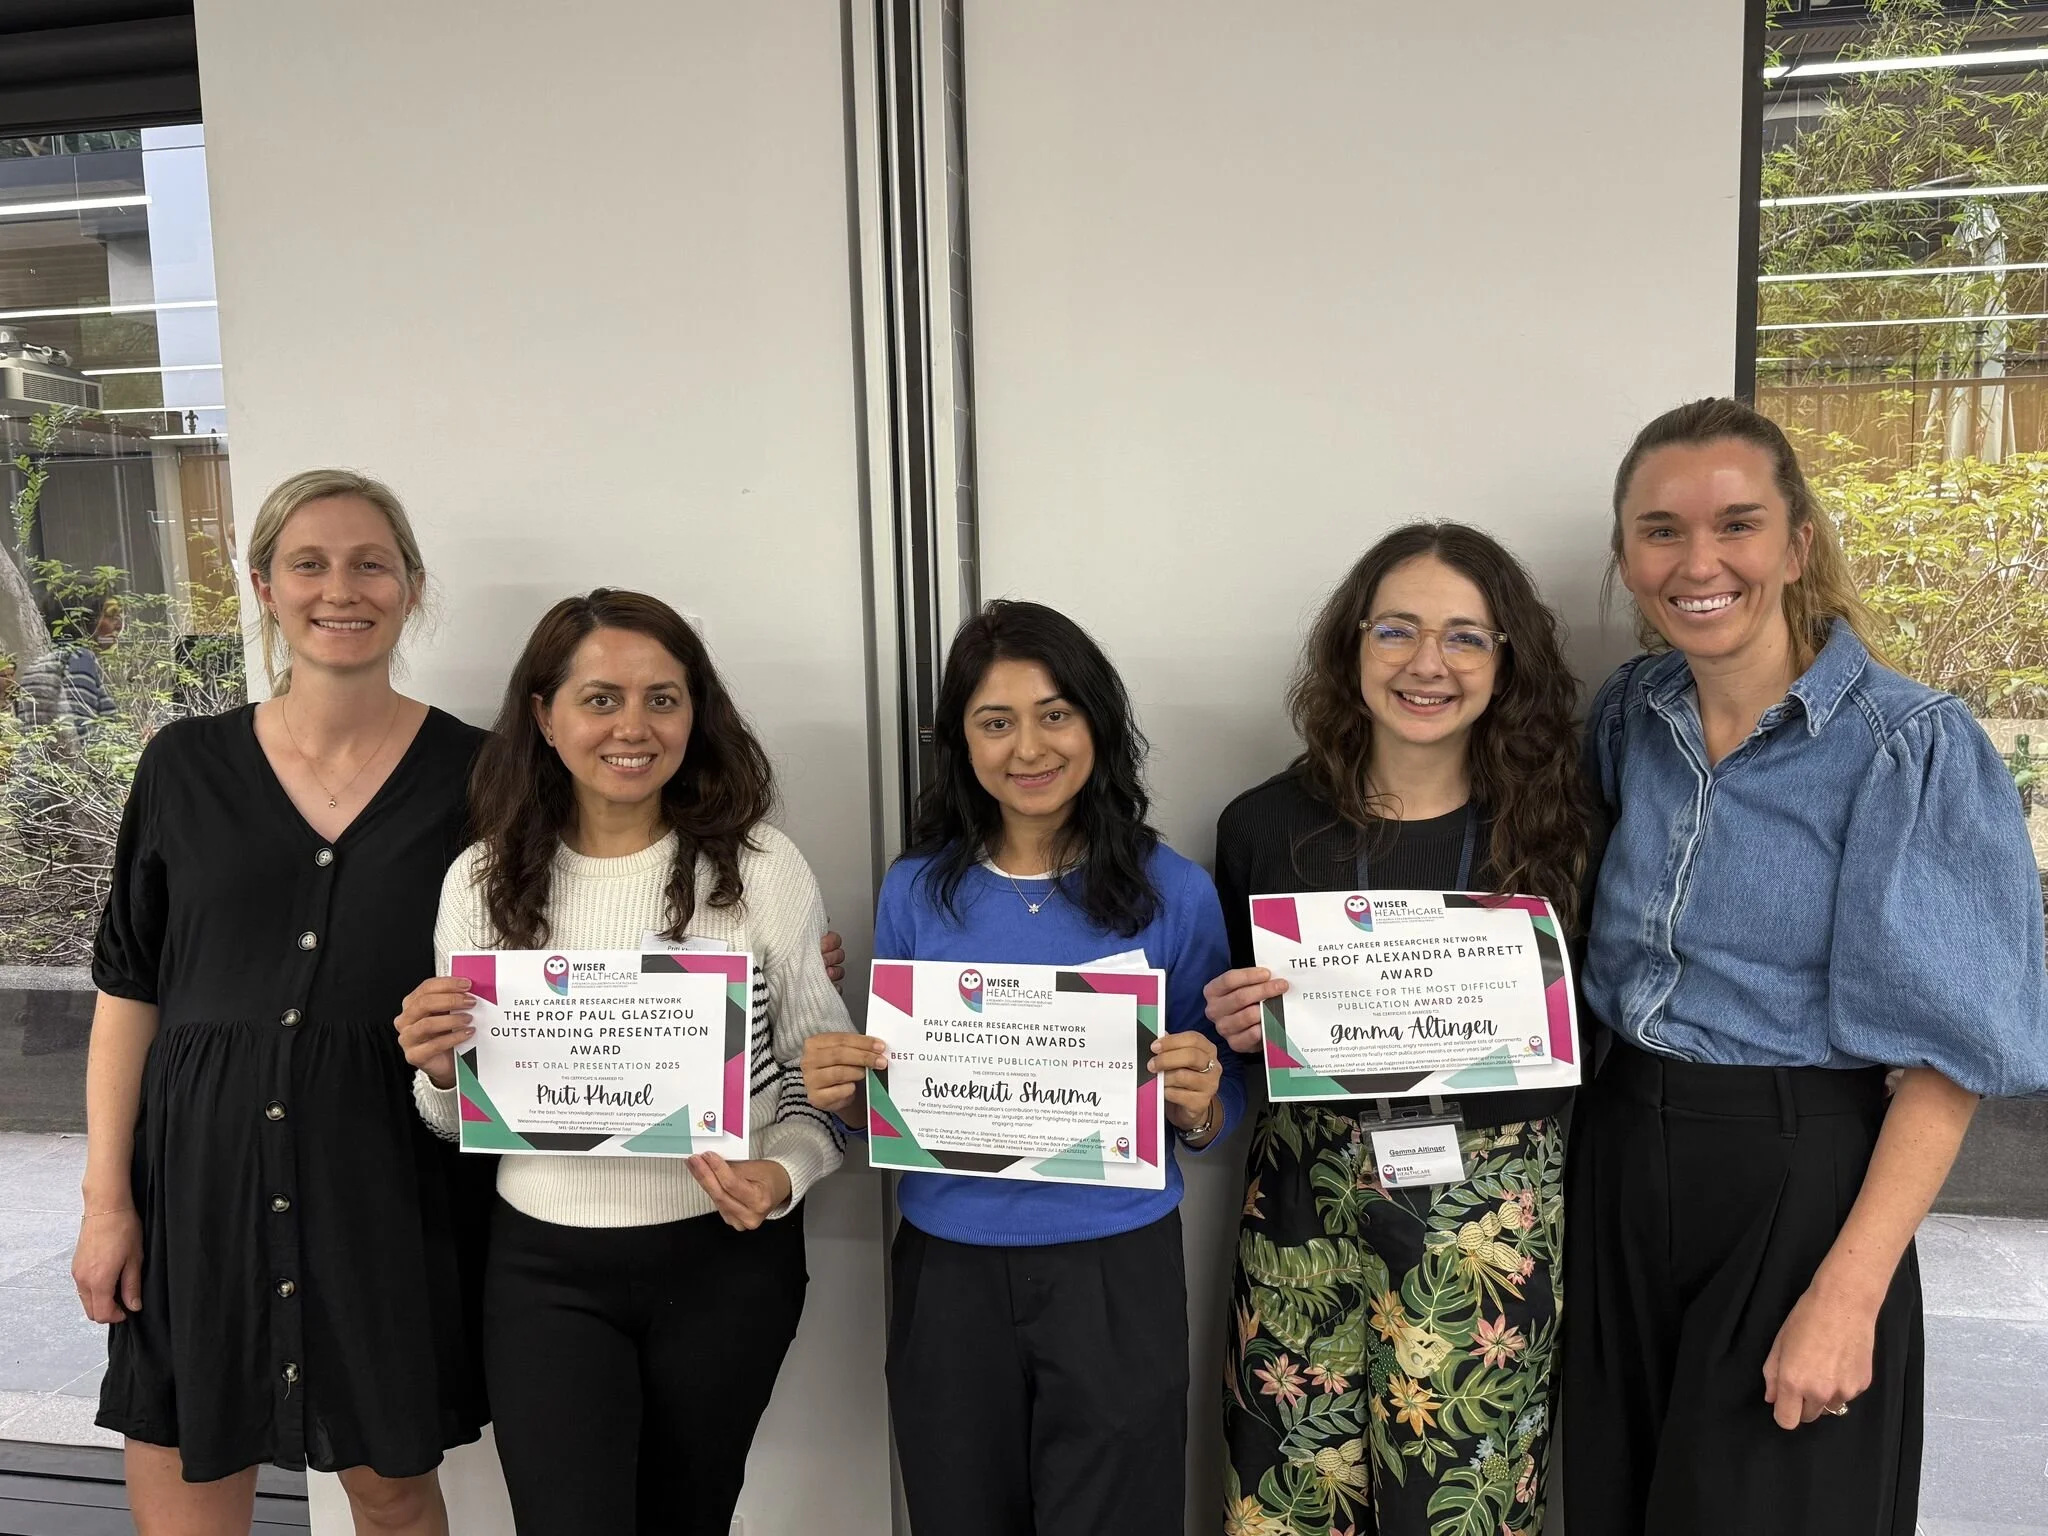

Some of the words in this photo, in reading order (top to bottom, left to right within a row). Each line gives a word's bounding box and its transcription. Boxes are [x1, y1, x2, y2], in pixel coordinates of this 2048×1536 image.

[1374, 908, 1444, 916] HEALTHCARE
[1384, 937, 1439, 946] RESEARCHER
[1289, 957, 1316, 968] THE
[1322, 954, 1358, 966] PROF
[1366, 948, 1451, 963] ALEXANDRA
[1458, 945, 1522, 957] BARRETT
[572, 972, 637, 980] HEALTHCARE
[1380, 967, 1432, 980] AWARD
[986, 978, 1019, 987] WISER
[986, 988, 1052, 999] HEALTHCARE
[1302, 989, 1371, 999] PERSISTENCE
[1376, 988, 1396, 996] FOR
[1400, 986, 1421, 994] THE
[1426, 984, 1455, 992] MOST
[1460, 980, 1516, 991] DIFFICULT
[1338, 1000, 1408, 1010] PUBLICATION
[1414, 997, 1452, 1006] AWARD
[1457, 995, 1483, 1004] 2025
[504, 1011, 530, 1020] THE
[536, 1010, 573, 1020] PROF
[580, 1010, 615, 1020] PAUL
[622, 1009, 693, 1019] GLASZIOU
[490, 1027, 592, 1037] OUTSTANDING
[600, 1026, 707, 1037] PRESENTATION
[986, 1022, 1039, 1030] RESEARCHER
[1408, 1016, 1498, 1040] Altinger
[926, 1031, 1019, 1045] PUBLICATION
[1026, 1036, 1085, 1048] AWARDS
[570, 1045, 620, 1054] AWARD
[890, 1052, 914, 1061] BEST
[918, 1053, 992, 1064] QUANTITATIVE
[998, 1057, 1067, 1066] PUBLICATION
[1072, 1059, 1103, 1068] PITCH
[1108, 1061, 1133, 1069] 2025
[536, 1084, 580, 1105] Priti
[583, 1083, 653, 1106] Kharel
[922, 1077, 1012, 1102] Sweekriti
[1019, 1081, 1101, 1106] Sharma
[1389, 1149, 1416, 1157] Gemma
[1418, 1146, 1446, 1154] Altinger
